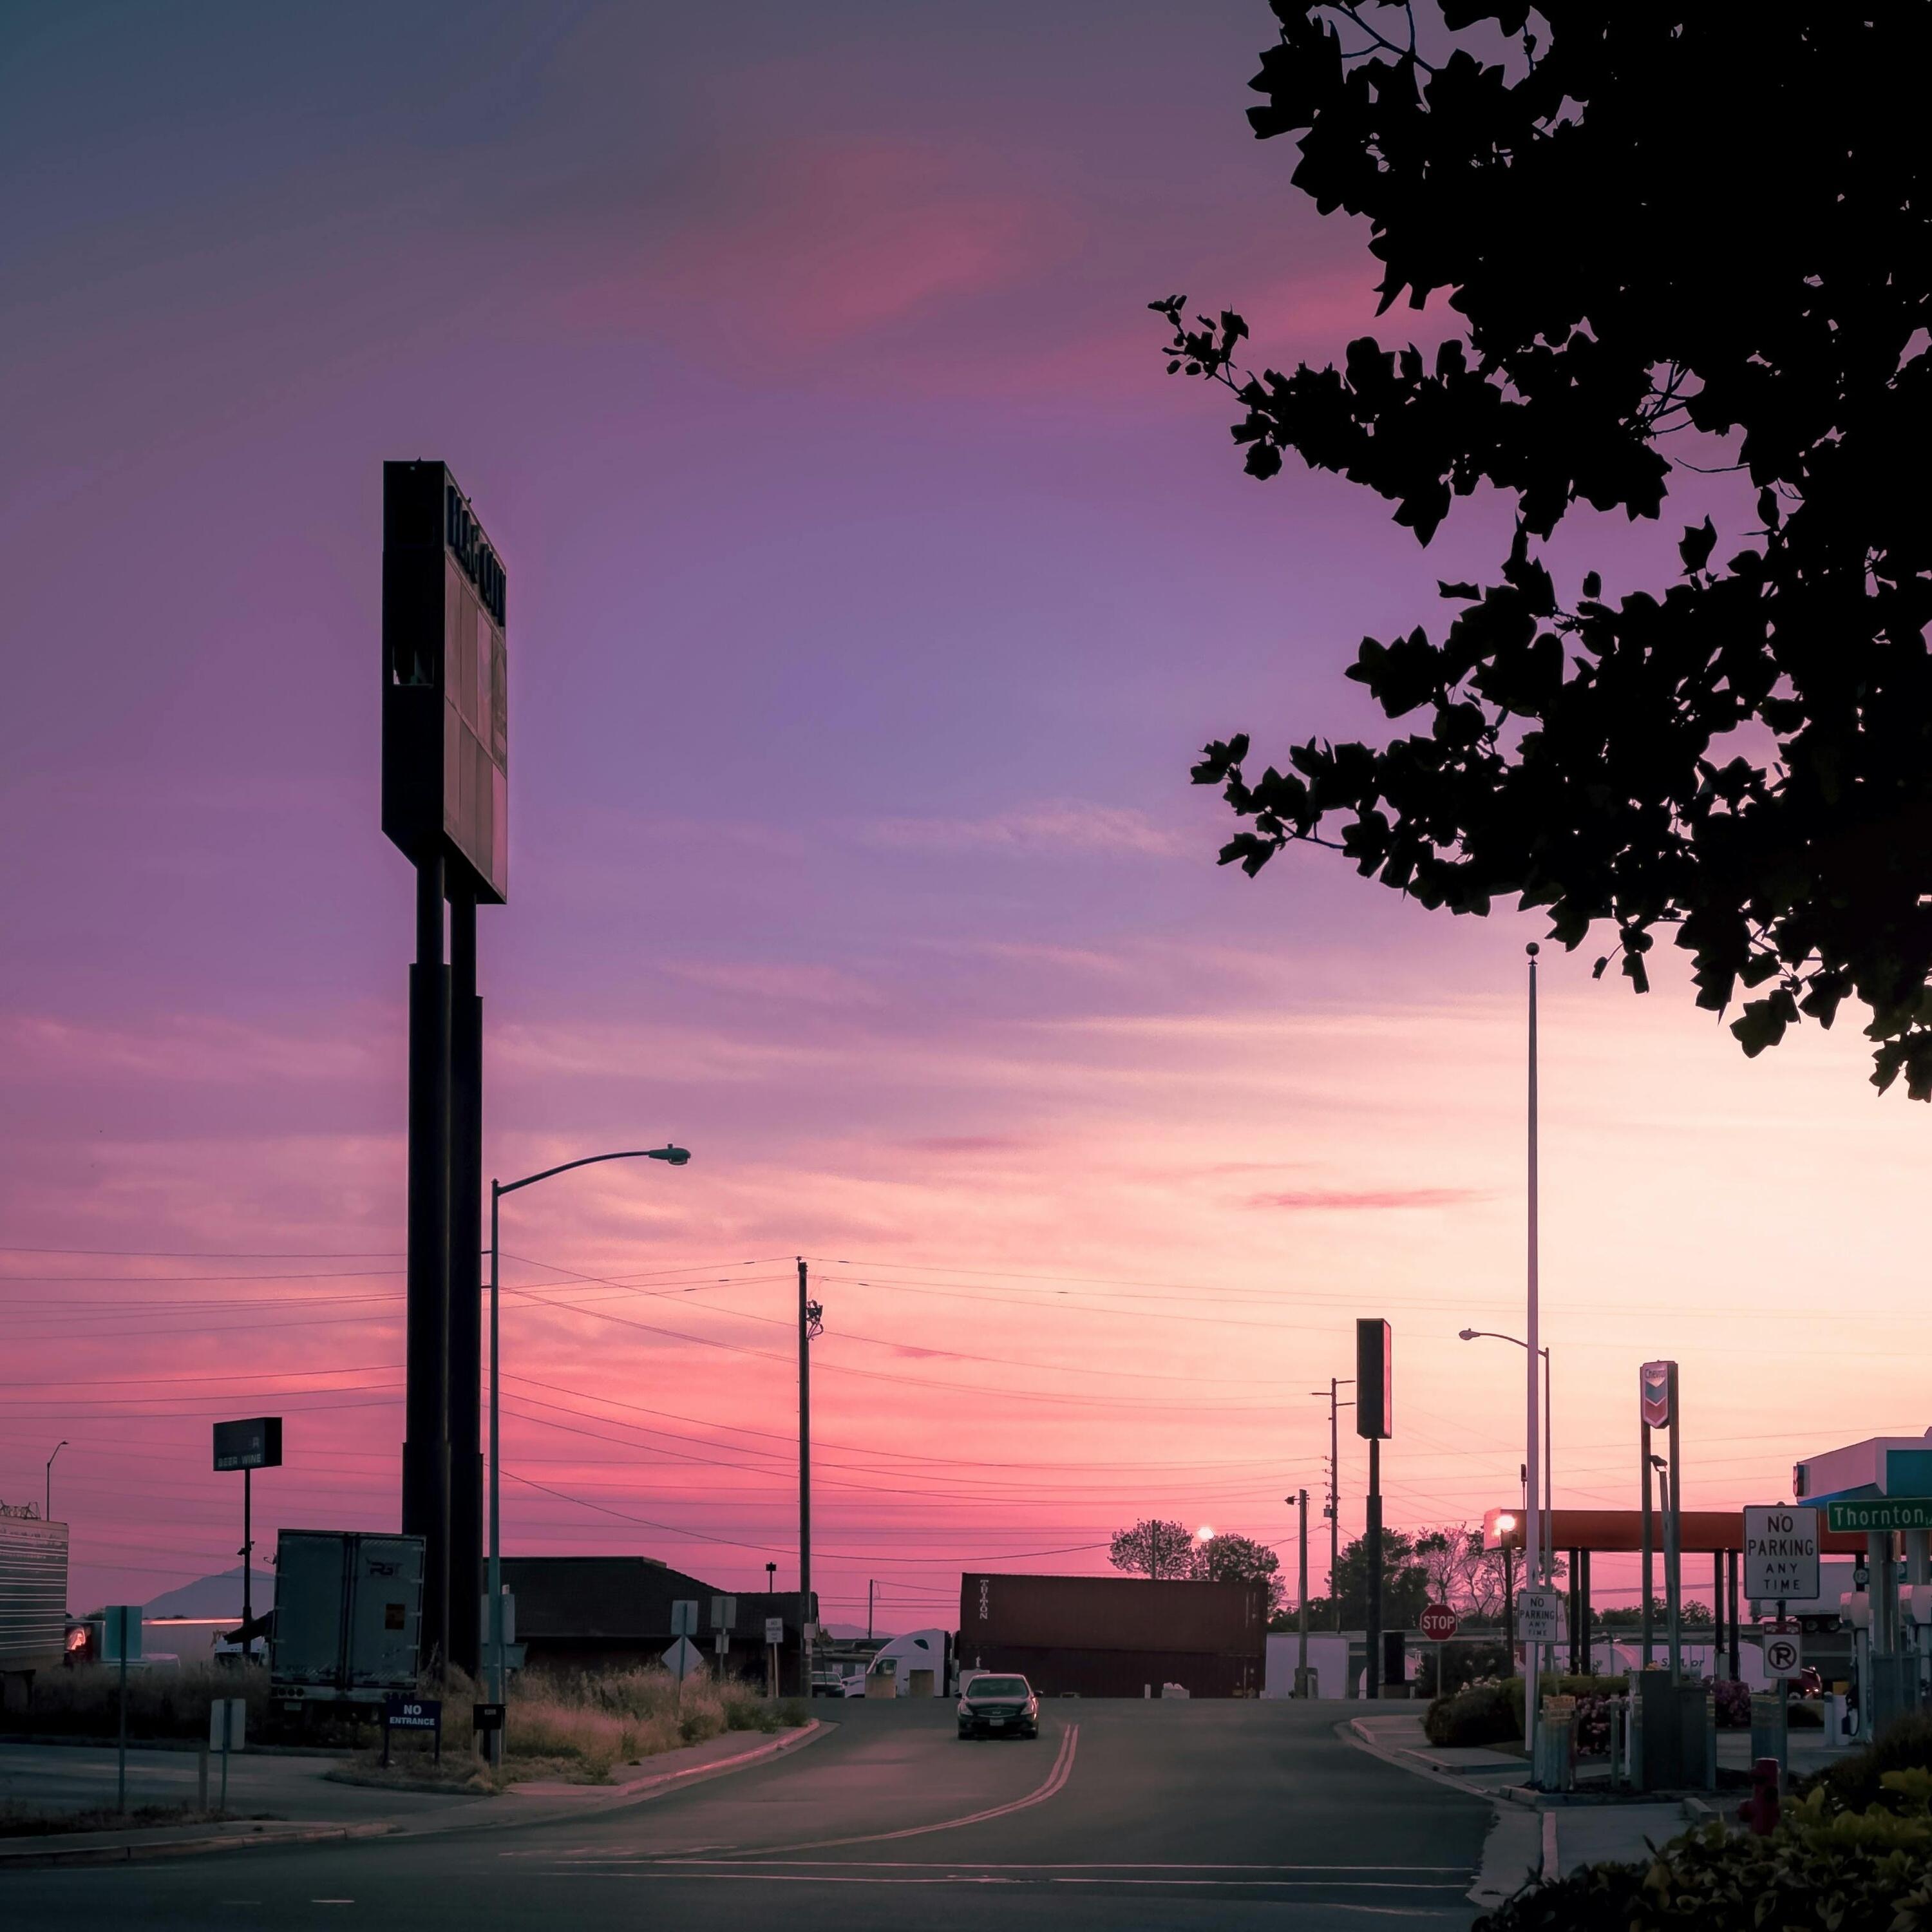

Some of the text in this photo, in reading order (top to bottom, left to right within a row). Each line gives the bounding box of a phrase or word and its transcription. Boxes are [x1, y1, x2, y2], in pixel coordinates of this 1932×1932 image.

[218, 1454, 261, 1467] BEER WINE
[1834, 1506, 1924, 1526] Thornton
[1767, 1515, 1794, 1533] NO
[1748, 1539, 1814, 1556] PARKING
[1766, 1563, 1798, 1573] ANY
[1857, 1572, 1866, 1580] 12
[1764, 1579, 1800, 1590] TIME
[1530, 1597, 1544, 1607] NO
[1520, 1610, 1555, 1620] PARKING
[1423, 1615, 1455, 1630] STOP
[403, 1705, 422, 1715] NO
[389, 1717, 435, 1726] ENTRANCE
